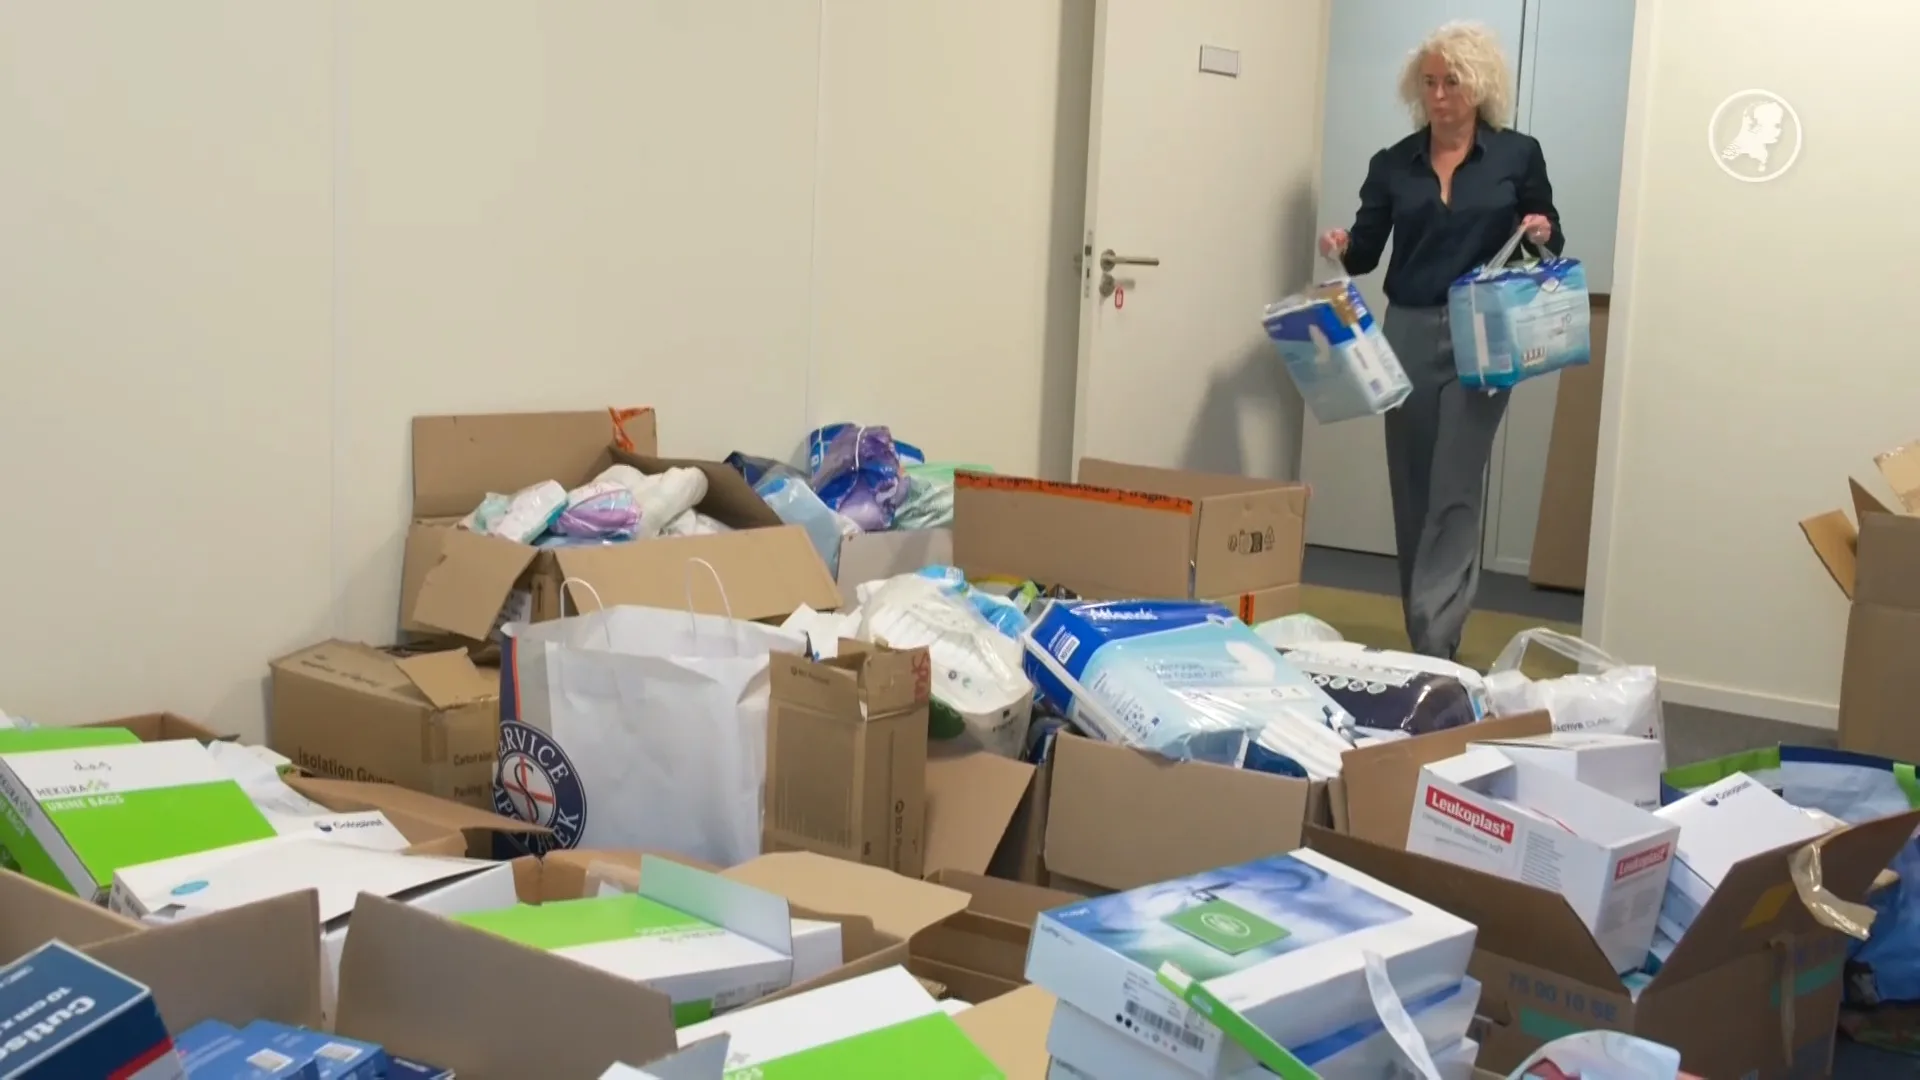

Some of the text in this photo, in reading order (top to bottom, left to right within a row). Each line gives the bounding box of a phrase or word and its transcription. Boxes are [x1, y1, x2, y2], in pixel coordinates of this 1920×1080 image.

[299, 747, 354, 779] Isolation
[499, 727, 569, 784] ERVICE
[87, 794, 124, 807] BAGS
[1431, 790, 1508, 839] Leukoplast
